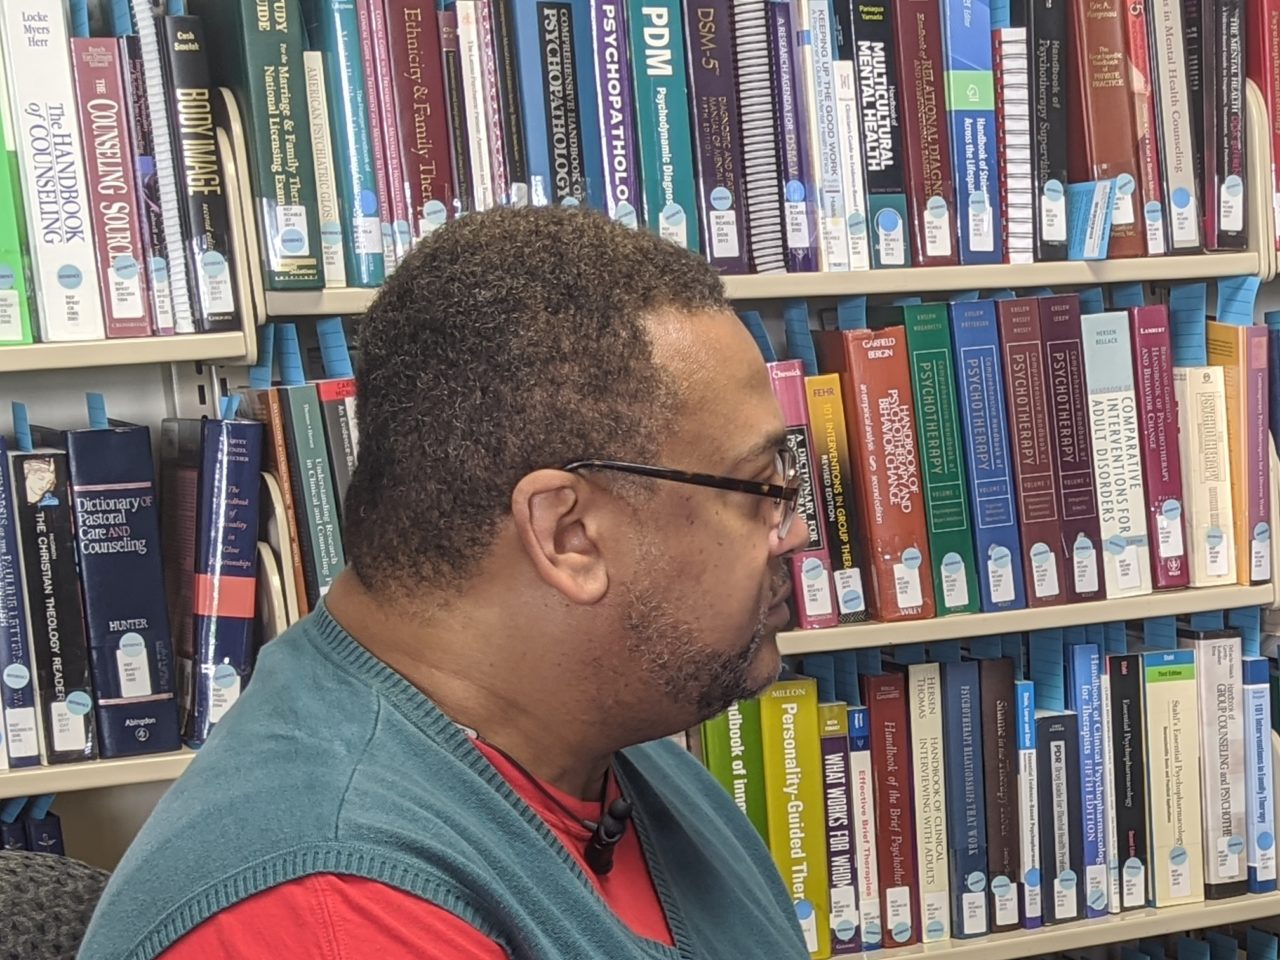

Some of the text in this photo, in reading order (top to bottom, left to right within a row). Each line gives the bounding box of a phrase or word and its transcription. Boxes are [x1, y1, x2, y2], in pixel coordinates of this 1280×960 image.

[22, 12, 48, 23] Locke
[23, 24, 50, 36] Myers
[27, 36, 48, 48] Herr
[697, 8, 720, 72] DSM-5
[1052, 39, 1061, 96] Handbook
[278, 66, 296, 174] Marriage Family
[306, 67, 328, 180] AMERICAN PSYCHIATRIC
[404, 7, 432, 159] Ethnicity Family
[543, 7, 570, 198] PSYCHOPATHOLOGY
[559, 9, 580, 183] COMPREHENSIVE HANDBOOK
[641, 7, 673, 163] PDM Psychodynamic
[817, 9, 839, 176] KEEPING GOOD WORK
[858, 41, 881, 172] MENTAL HEALTH
[871, 42, 894, 170] MULTICULTURAL
[888, 85, 898, 118] Handbook
[922, 60, 938, 142] RELATIONAL
[964, 118, 974, 145] Across
[1038, 38, 1050, 122] Psychotherapy
[1165, 23, 1183, 173] Mental Health Counseling
[30, 124, 63, 245] COUNSELING
[48, 103, 85, 243] The HANDBOOK
[87, 99, 128, 195] COUNSELING
[176, 88, 221, 196] BODY IMAGE
[264, 66, 286, 207] National Licensing Exam
[976, 118, 988, 158] Handbook
[813, 387, 835, 397] FEHR
[862, 337, 896, 348] GARFIELD
[868, 349, 893, 359] BERGIN
[879, 398, 901, 506] BEHAVIOR CHANGE
[919, 362, 944, 474] PSYCHOTHERAPY
[966, 358, 990, 470] PSYCHOTHERAPY
[1012, 353, 1036, 466] PSYCHOTHERAPY
[1052, 352, 1075, 464] PSYCHOTHERAPY
[1121, 396, 1141, 489] COMPARATIVE
[76, 496, 140, 513] Dictionary
[315, 458, 339, 565] Understanding Research
[825, 421, 848, 539] INTERVENTIONS GROUP
[1091, 399, 1115, 524] ADULT DISORDERS
[1106, 397, 1131, 534] INTERVENTIONS FOR
[78, 510, 127, 527] Pastoral
[80, 525, 131, 540] Care AND
[81, 538, 147, 555] Counseling
[308, 470, 329, 575] Clinical Counseling
[35, 512, 64, 702] THE CHRISTIAN THEOLOGY READER
[109, 618, 148, 632] HUNTER
[124, 716, 156, 727] Abingdon
[771, 688, 806, 698] MILLON
[917, 676, 927, 720] THOMAS
[927, 676, 936, 715] HERSEN
[1081, 702, 1093, 753] Therapists
[1090, 654, 1100, 708] Handbook
[781, 702, 806, 858] Personality-Guided
[824, 752, 849, 853] WHAT WORKS FOR
[884, 721, 902, 833] Handbook Brief
[920, 738, 935, 886] INTERVIEWING ADULTS
[930, 737, 944, 863] HANDBOOK CLINICAL
